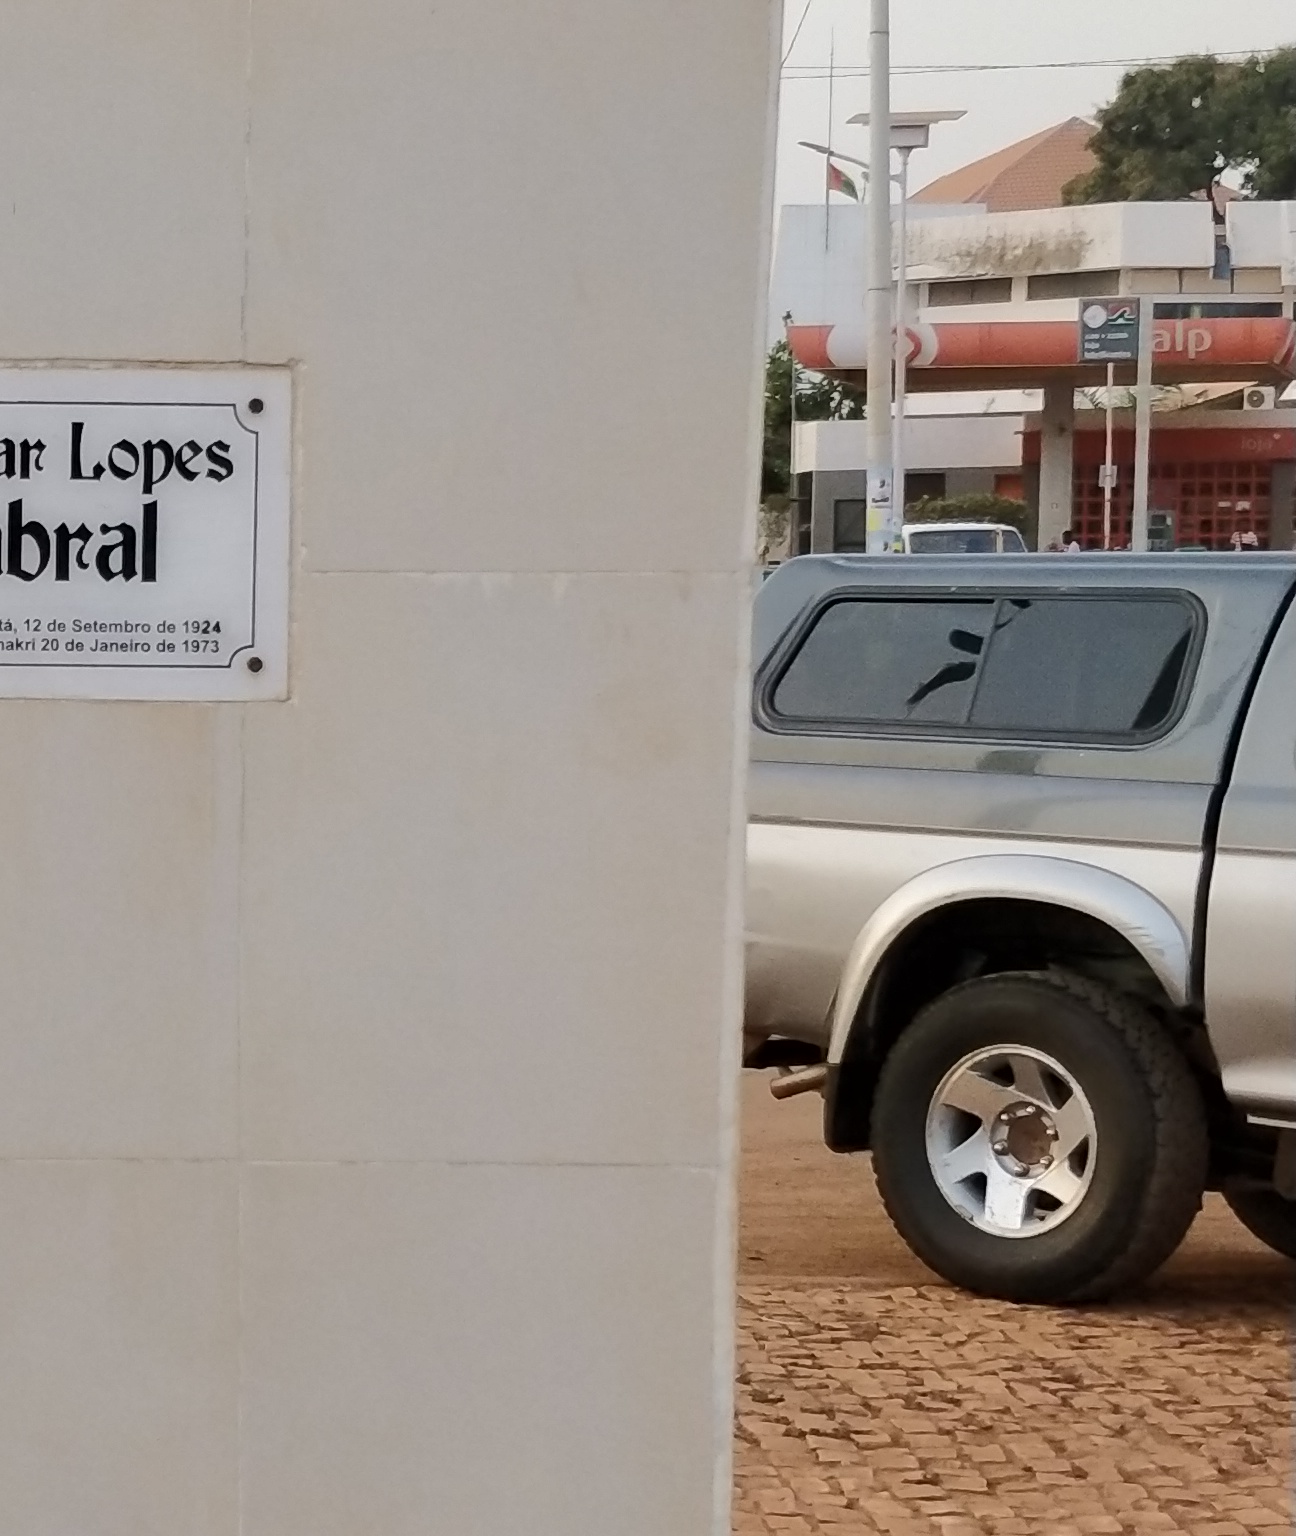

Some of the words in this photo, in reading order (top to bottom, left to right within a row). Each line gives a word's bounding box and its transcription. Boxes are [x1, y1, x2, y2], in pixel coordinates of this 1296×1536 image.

[1152, 321, 1213, 360] alp
[69, 421, 235, 495] Lopes
[23, 618, 42, 633] 12
[46, 619, 67, 633] de
[71, 618, 151, 634] Setembro
[156, 620, 176, 634] de
[182, 620, 222, 635] 1924
[40, 638, 60, 652] 20
[64, 638, 85, 652] de
[89, 638, 151, 652] Janeiro
[156, 639, 176, 653] de
[181, 640, 220, 654] 1973
